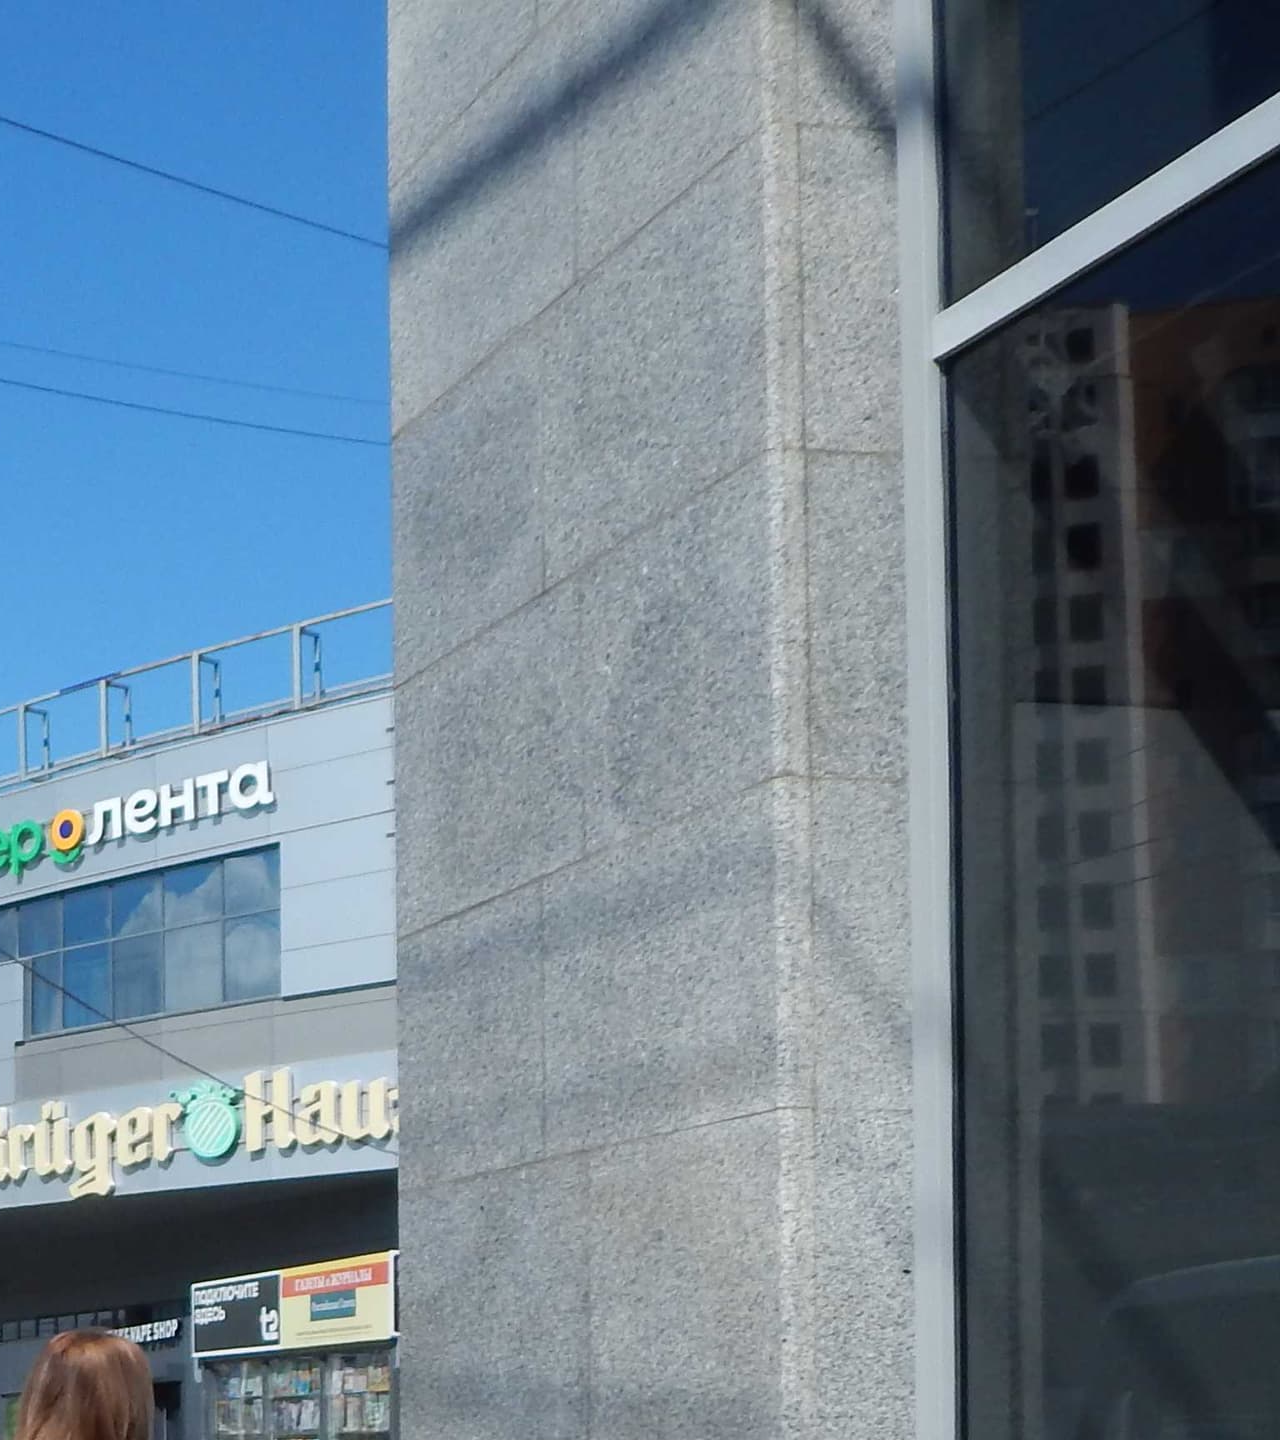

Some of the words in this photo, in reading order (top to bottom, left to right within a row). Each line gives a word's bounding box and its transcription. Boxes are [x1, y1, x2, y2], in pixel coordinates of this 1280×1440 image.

[85, 758, 276, 847] лента
[194, 1281, 260, 1306] ПОДКЛЮЧИТЕ
[153, 1318, 178, 1340] SHOP
